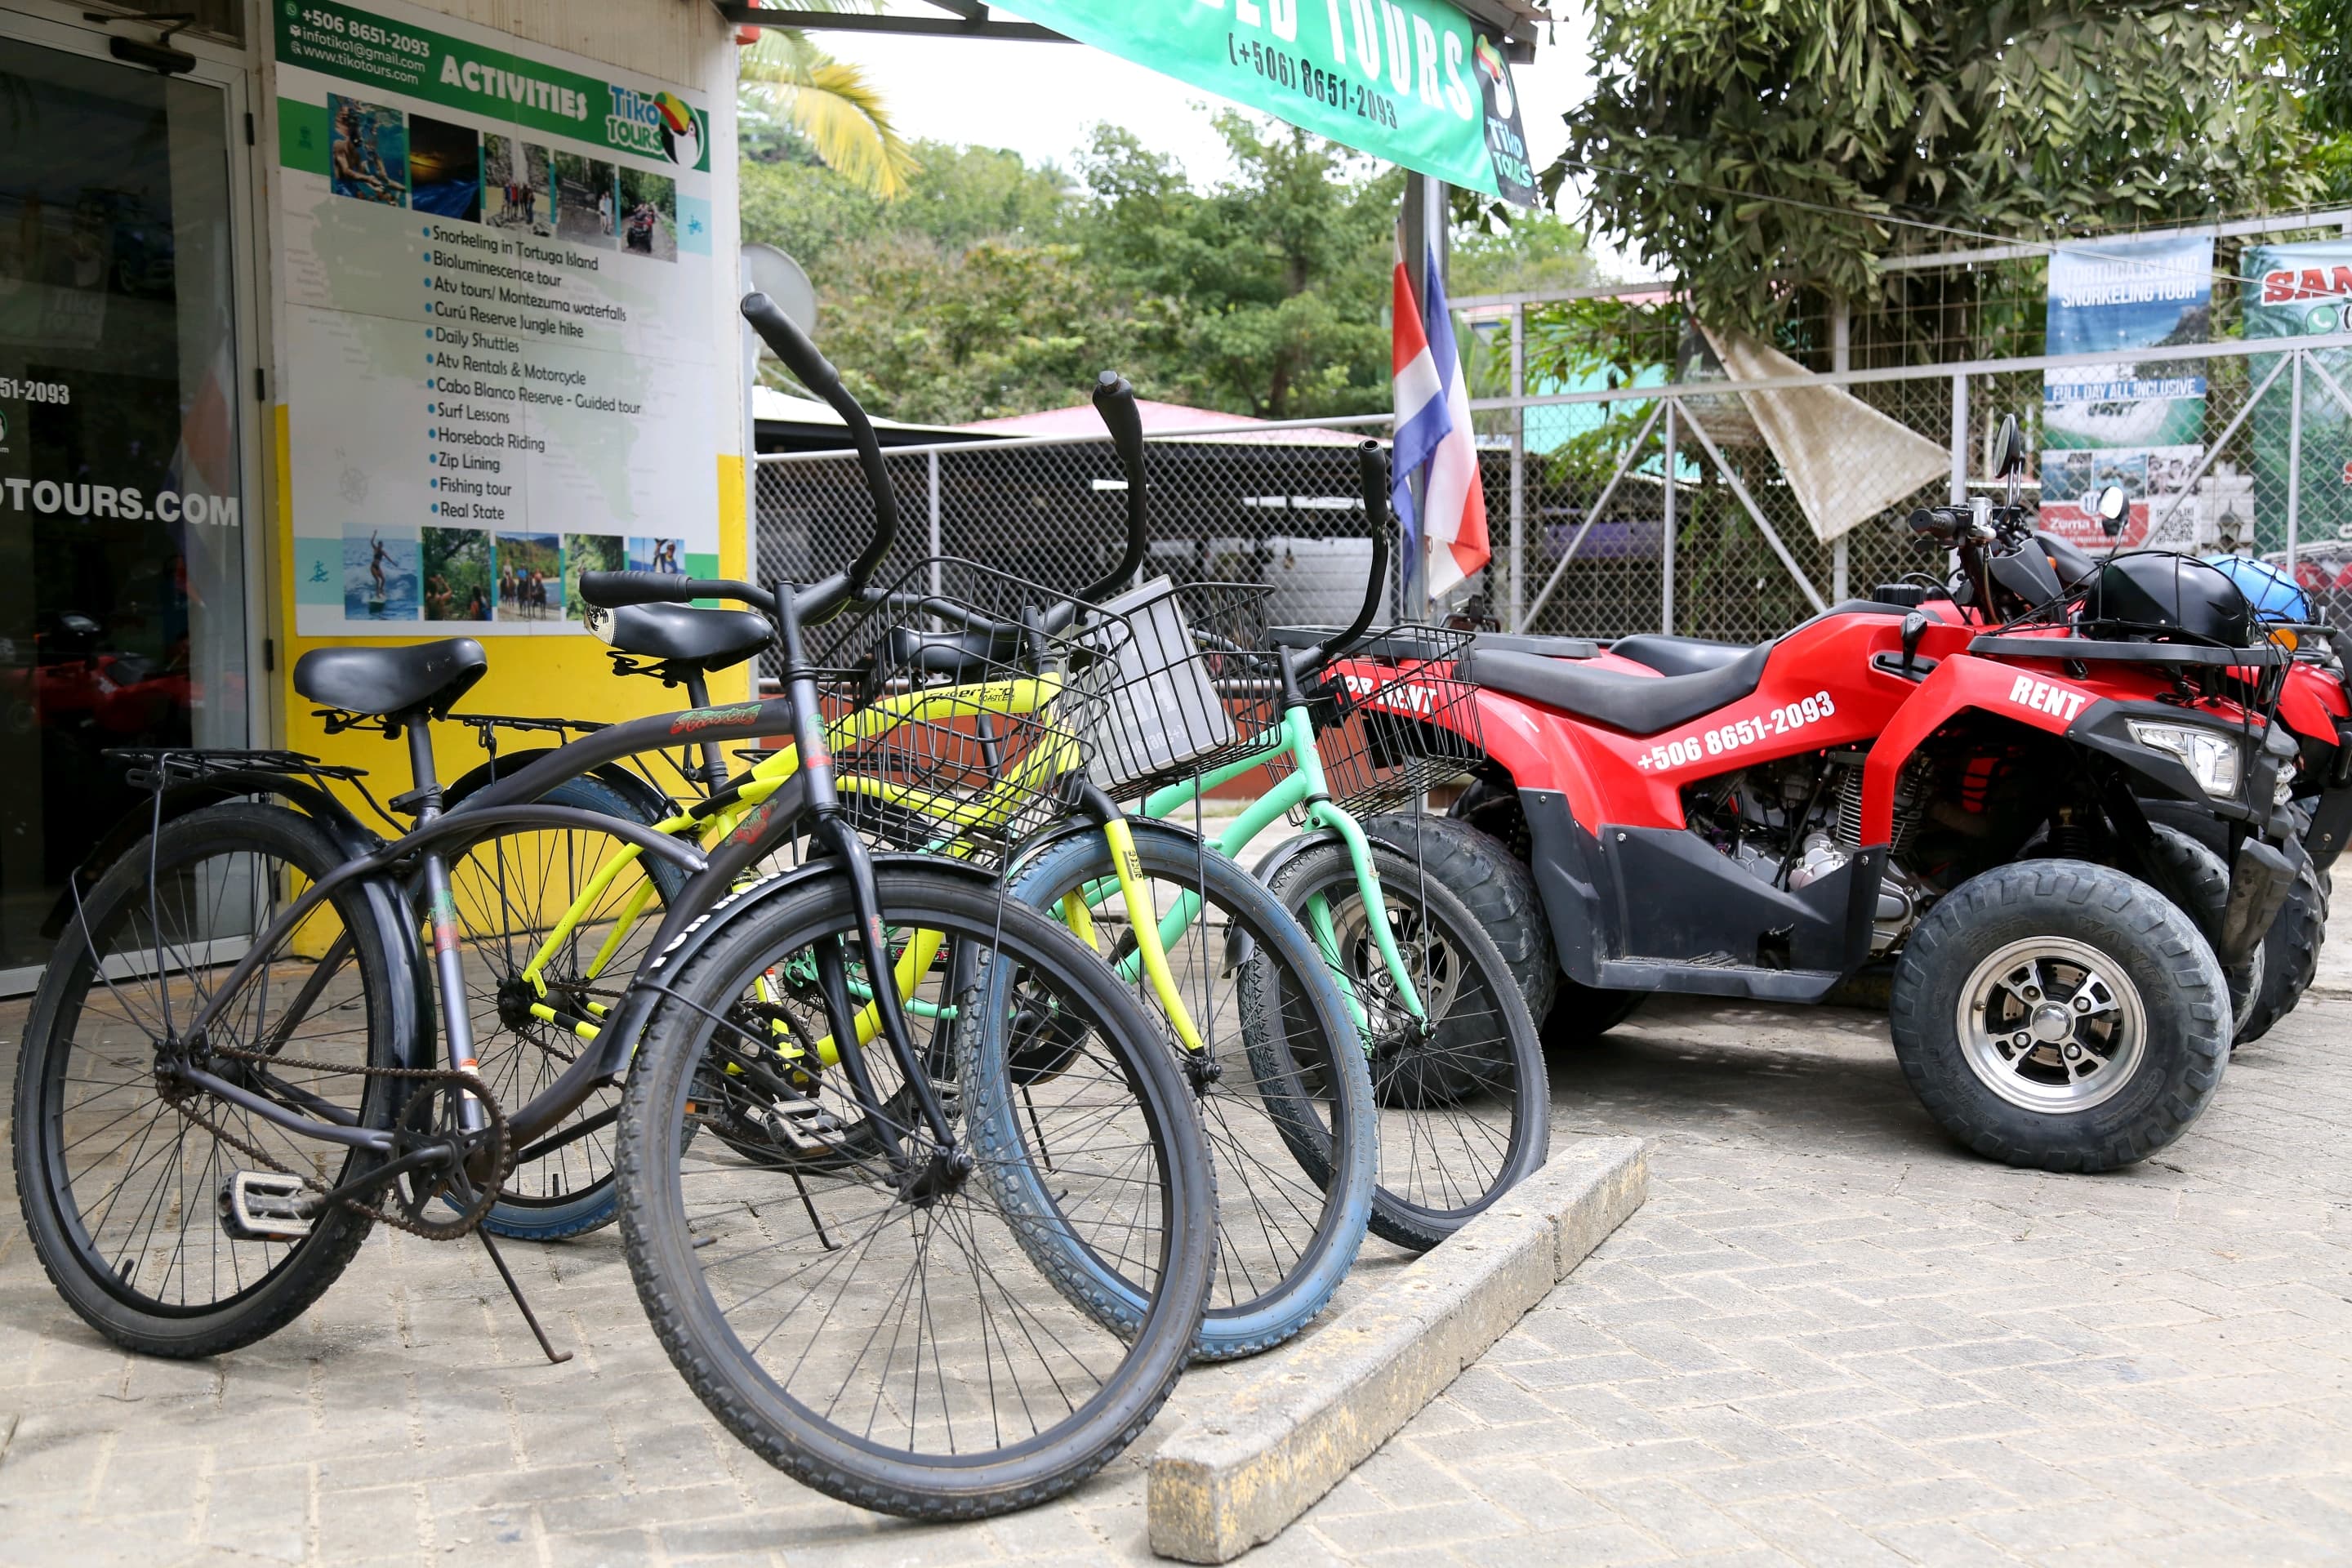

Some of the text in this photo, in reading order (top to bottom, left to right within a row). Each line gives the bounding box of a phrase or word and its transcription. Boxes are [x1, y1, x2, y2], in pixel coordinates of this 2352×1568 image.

[302, 10, 430, 58] +506 8651-2093
[303, 27, 425, 72] infotiko1@gmail.com
[303, 45, 419, 85] www.tikotours.com
[1228, 32, 1397, 129] (+506) 8651-2093
[439, 54, 588, 121] ACTIVITIES
[609, 85, 660, 127] Tiko
[606, 116, 664, 154] TOURS
[1487, 115, 1524, 160] Tiko
[433, 225, 599, 270] Snorkeling in Tortuga Island
[434, 250, 562, 287] Bioluminescence tour
[434, 275, 457, 293] Atv
[499, 287, 570, 313] Montezuma
[572, 304, 626, 322] waterfalls
[2061, 279, 2197, 308] SNORKELING TOUR
[434, 300, 584, 337] Curú Reserve Jungle hike
[435, 326, 519, 353] Daily Shuttles
[436, 352, 586, 386] Atv Rentals & Motorcycle
[437, 376, 471, 395] Cabo
[474, 381, 516, 401] Blanco
[519, 386, 564, 406] Reserve
[575, 393, 616, 412] Guided
[618, 399, 641, 415] tour
[2083, 384, 2107, 400] DAY
[2109, 381, 2132, 399] ALL
[2133, 378, 2196, 398] INCLUSIVE
[438, 402, 510, 424] Surf Lessons
[439, 426, 546, 453] Horseback Riding
[439, 451, 501, 474] Zip Lining
[439, 476, 512, 497] Fishing tour
[440, 501, 505, 520] Real State
[1334, 673, 1374, 695] OR
[2009, 675, 2086, 722] RENT
[1637, 690, 1835, 770] +506 8651-2093
